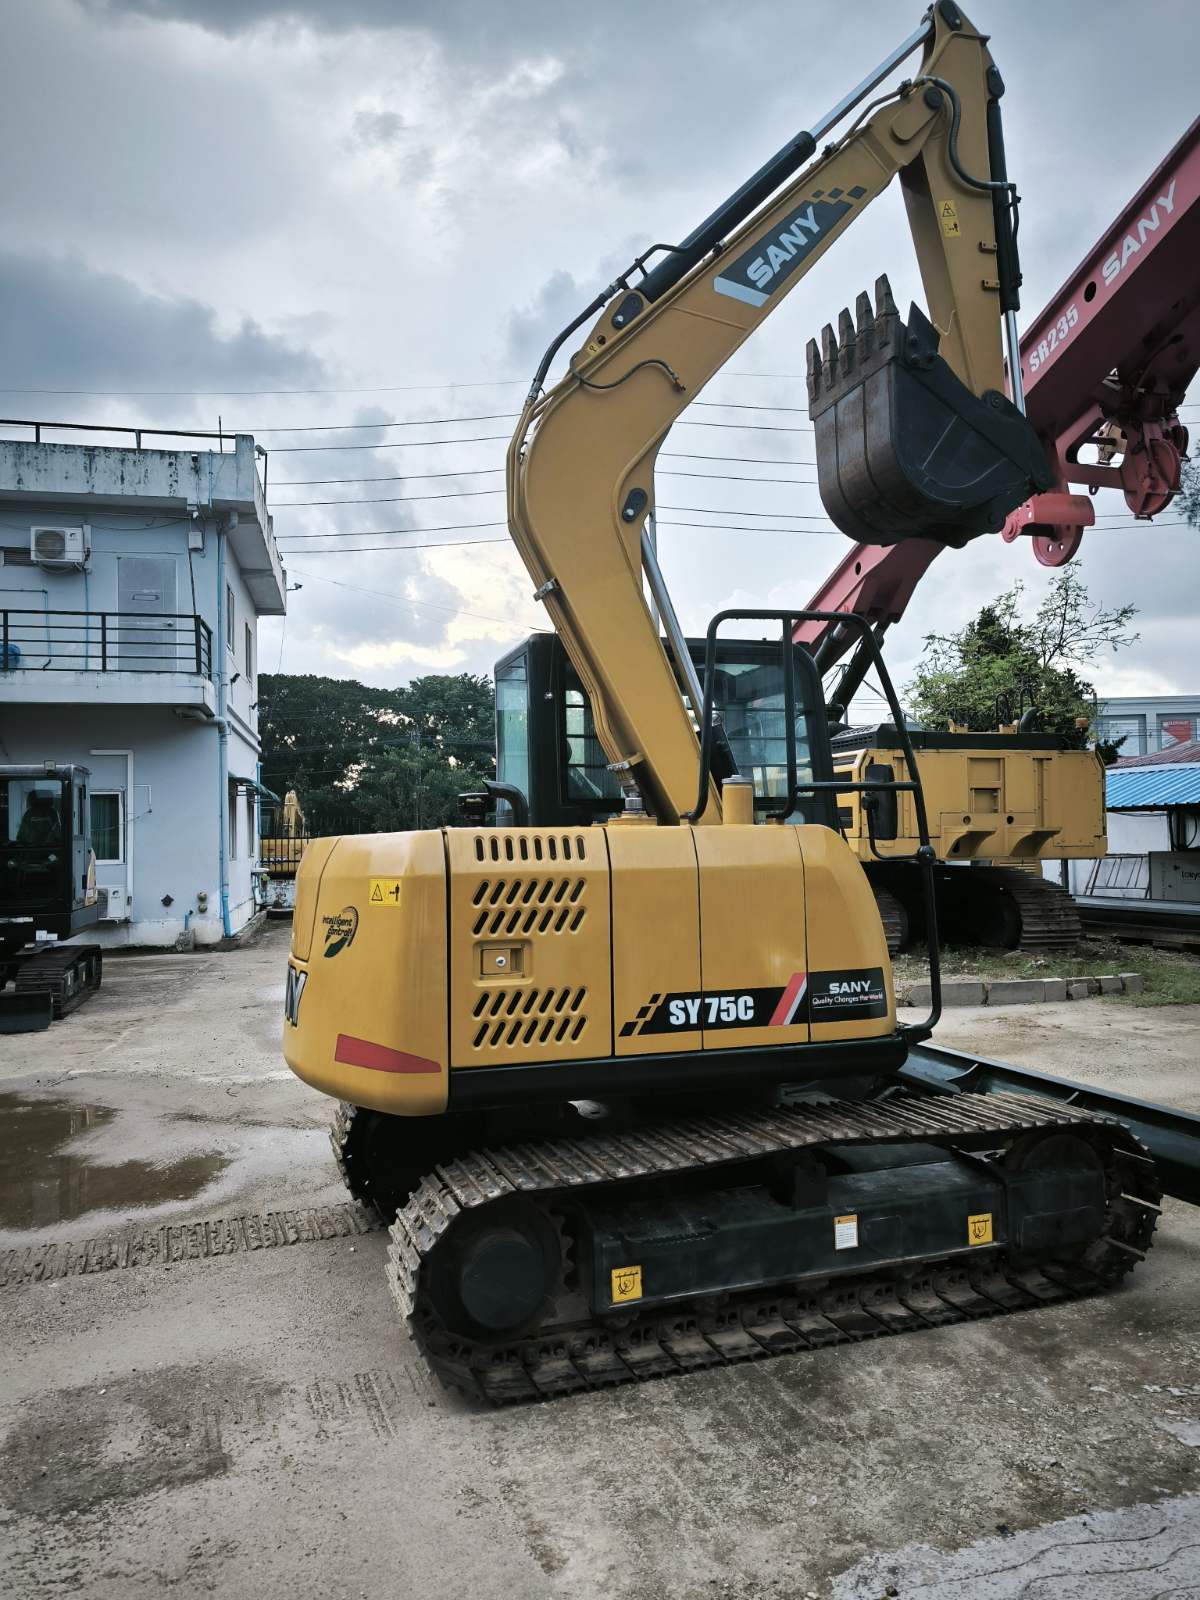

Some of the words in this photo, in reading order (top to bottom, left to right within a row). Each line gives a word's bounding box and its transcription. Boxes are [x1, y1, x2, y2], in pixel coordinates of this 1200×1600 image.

[746, 204, 821, 289] SANY
[1101, 180, 1178, 287] SANY
[1029, 303, 1079, 373] SR235
[829, 980, 871, 994] SANY
